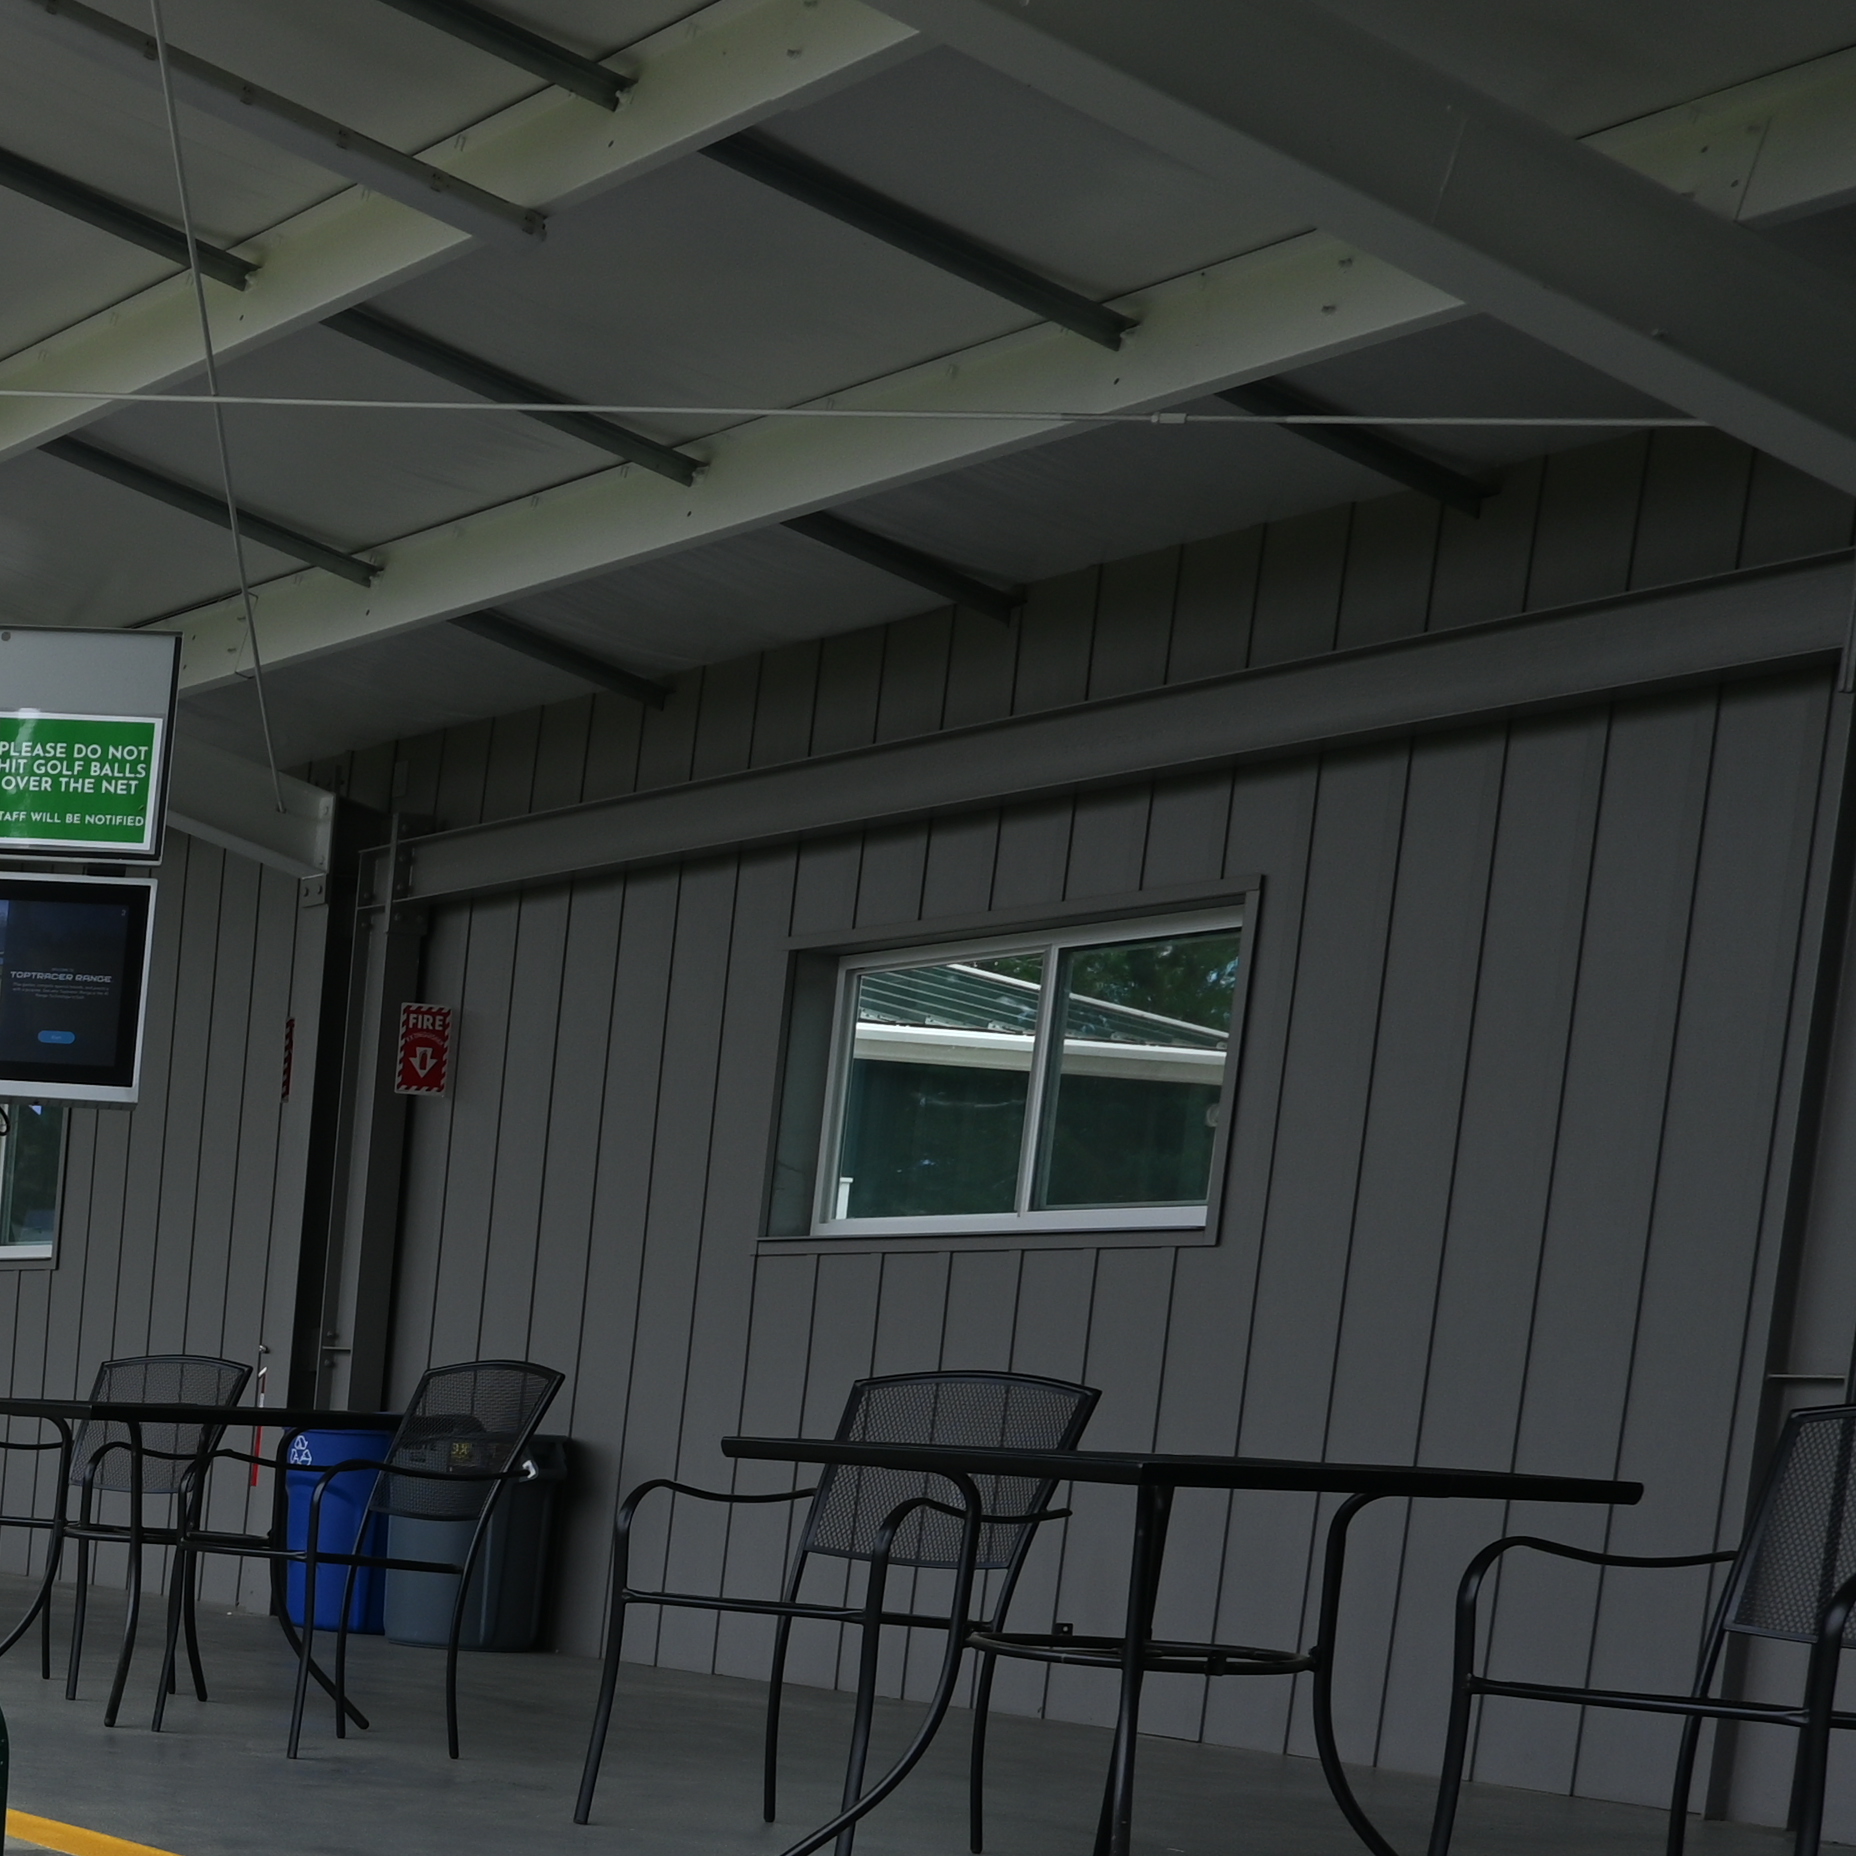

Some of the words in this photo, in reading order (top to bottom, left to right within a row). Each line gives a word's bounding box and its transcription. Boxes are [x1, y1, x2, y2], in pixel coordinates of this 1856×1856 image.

[73, 743, 102, 759] DO
[108, 745, 149, 761] NOT
[33, 759, 84, 775] GOLF
[90, 762, 146, 778] BALLS
[1, 776, 52, 792] OVER
[59, 777, 95, 793] THE
[101, 779, 139, 795] NET
[31, 812, 61, 823] WILL
[65, 813, 81, 824] BE
[85, 814, 144, 827] NOTIFIED
[10, 971, 73, 981] TOPTRACER
[75, 974, 112, 983] RANGE
[408, 1014, 444, 1030] FIRE
